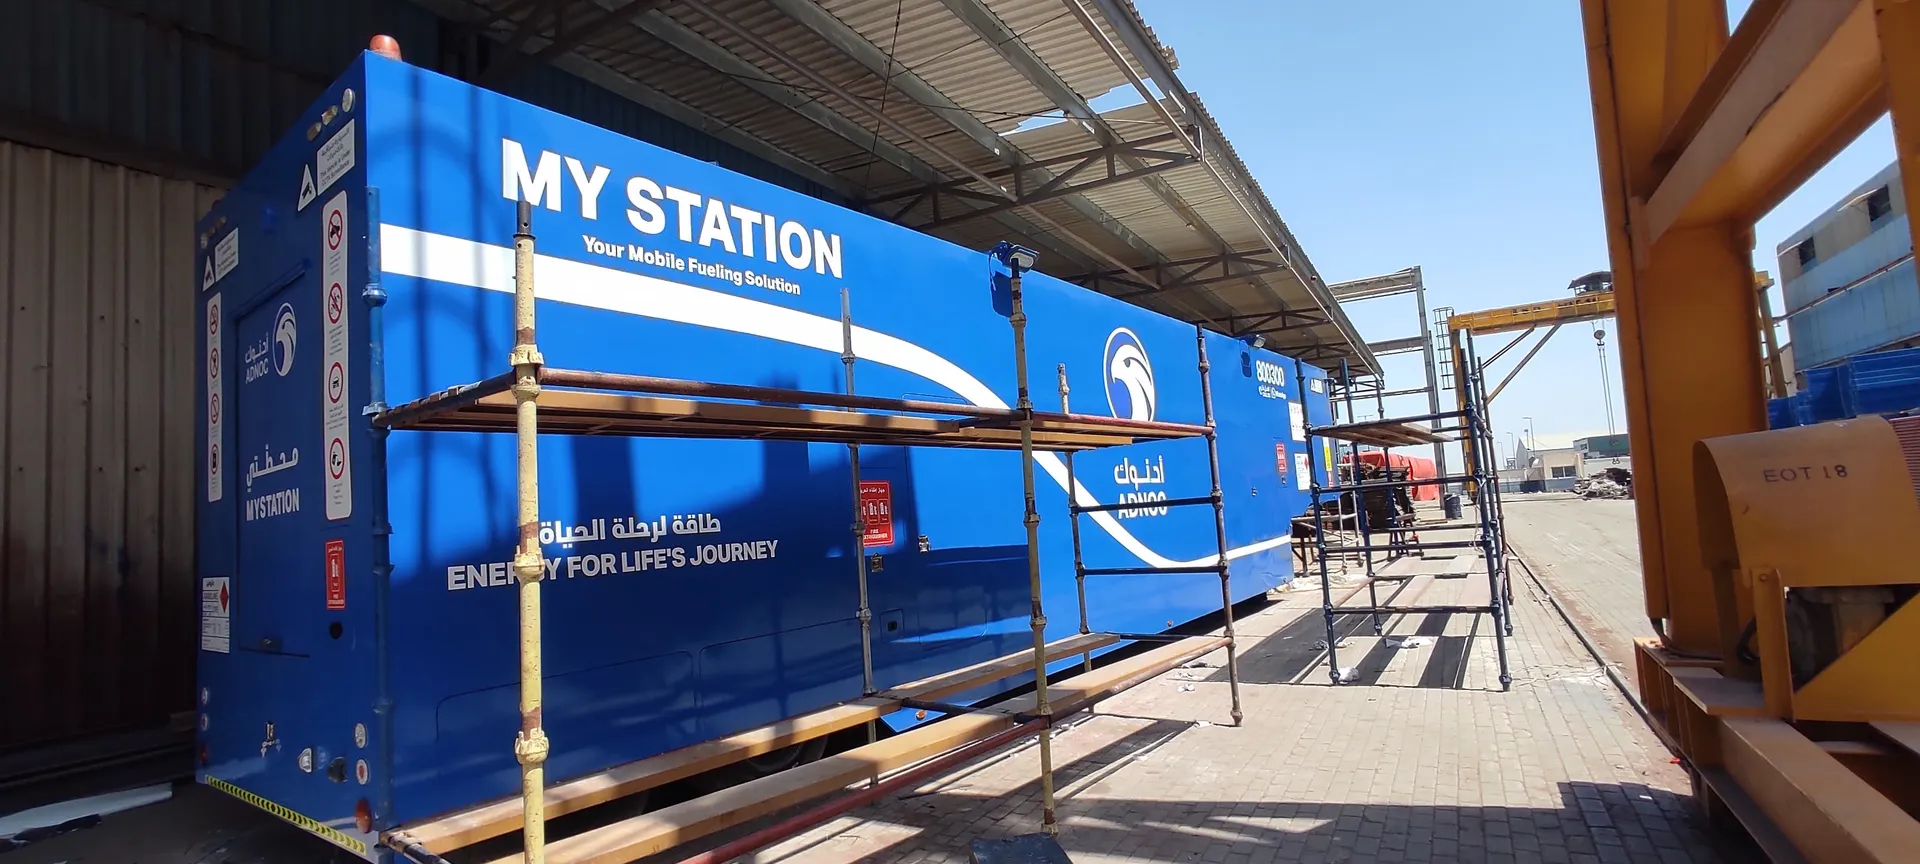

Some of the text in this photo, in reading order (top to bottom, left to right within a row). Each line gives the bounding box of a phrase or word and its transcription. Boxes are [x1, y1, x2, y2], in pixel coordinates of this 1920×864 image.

[502, 138, 843, 279] MY STATION
[582, 234, 801, 295] Your Mobile Fueling Solution
[245, 357, 268, 385] ADNOC
[1255, 359, 1285, 387] 800300
[1114, 454, 1165, 491] أدنوك
[1763, 464, 1848, 483] EOT 18
[246, 487, 300, 521] MYSTATION
[1118, 491, 1168, 520] ADNOC
[539, 513, 721, 549] طاقة لرحلة الحياة
[567, 553, 618, 579] FOR
[621, 546, 686, 573] LIFE'S
[689, 539, 779, 567] JOURNEY
